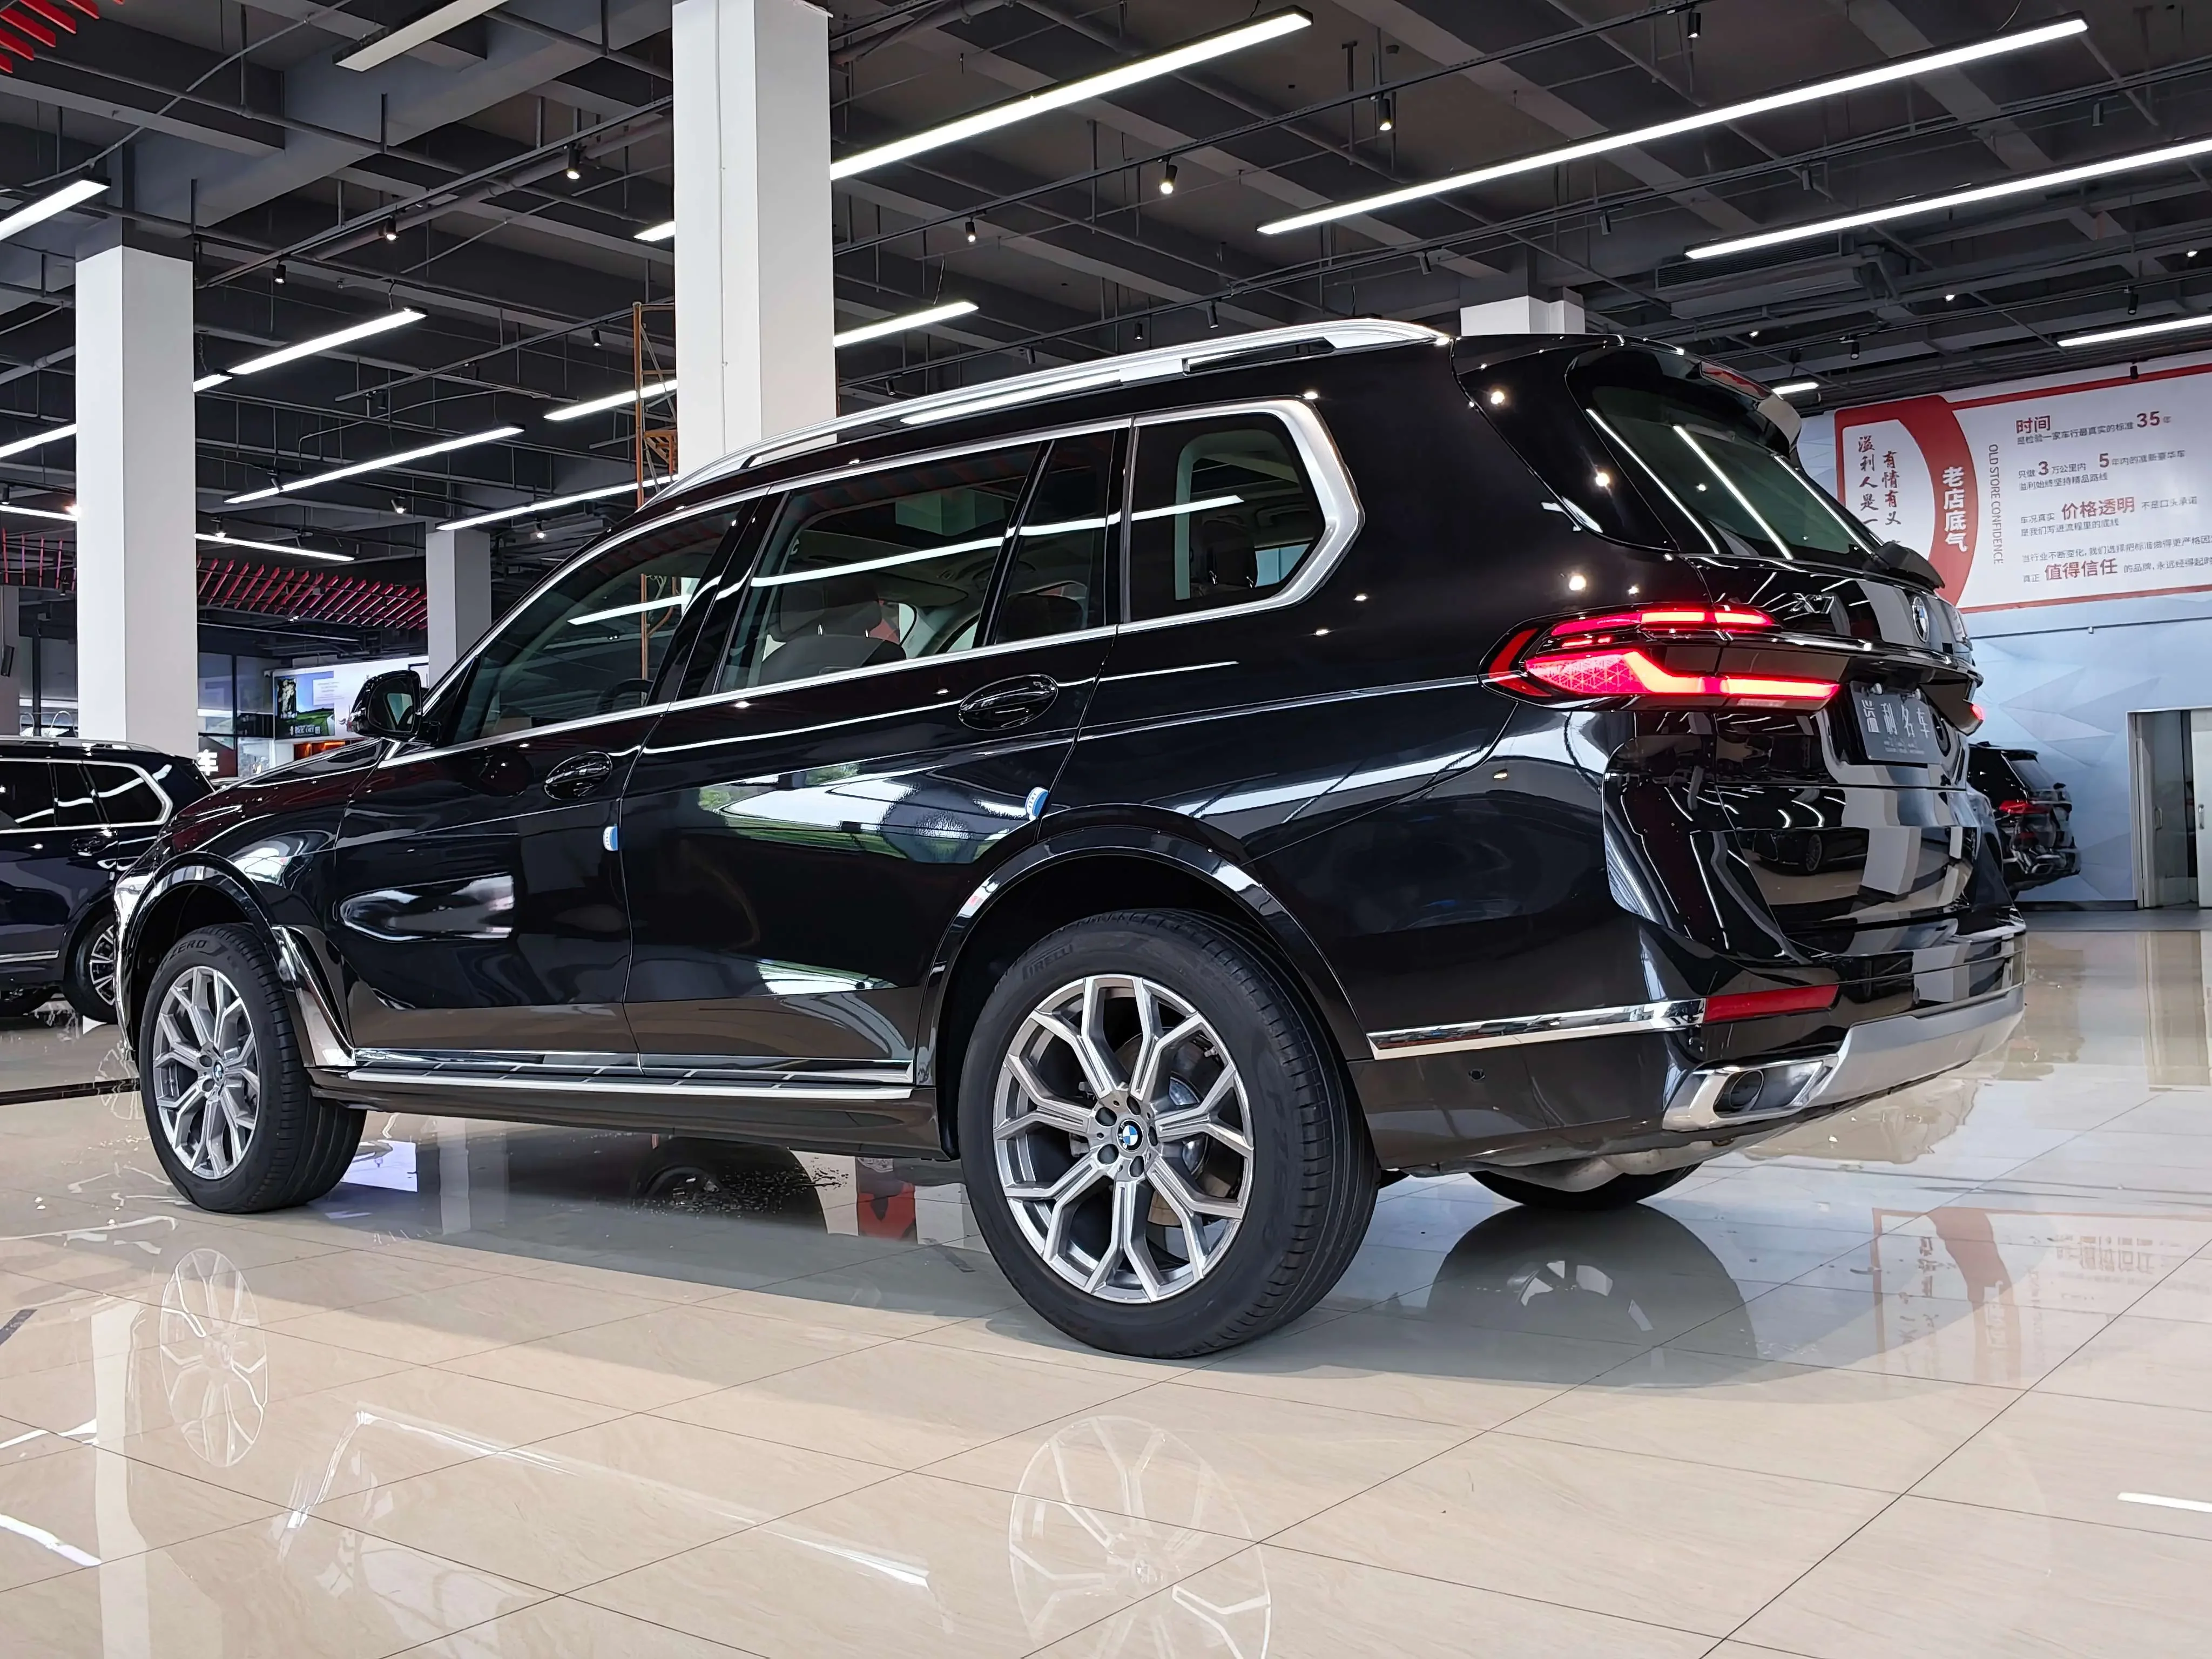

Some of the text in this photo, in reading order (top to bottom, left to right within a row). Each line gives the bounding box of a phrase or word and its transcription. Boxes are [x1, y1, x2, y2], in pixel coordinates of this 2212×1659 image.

[2016, 415, 2051, 433] 时间
[2017, 422, 2134, 445] 是检验一家车行最真实的标准
[2136, 411, 2160, 428] 35
[2018, 469, 2035, 478] 只做
[2038, 461, 2049, 476] 3
[2052, 463, 2086, 474] 万公里内
[2099, 453, 2109, 468] 5
[1881, 450, 1901, 543] 有情有义
[1943, 466, 1967, 552] 老店底气
[1988, 444, 2004, 564] OLD STORE CONFIDENCE
[2021, 496, 2197, 523] 车况真实 价格透明 不是口头承诺
[2021, 518, 2120, 537] 是我们写进流程里的底线
[2024, 574, 2040, 583] 真正
[2045, 558, 2117, 581] 值得信任
[197, 748, 219, 776] 车
